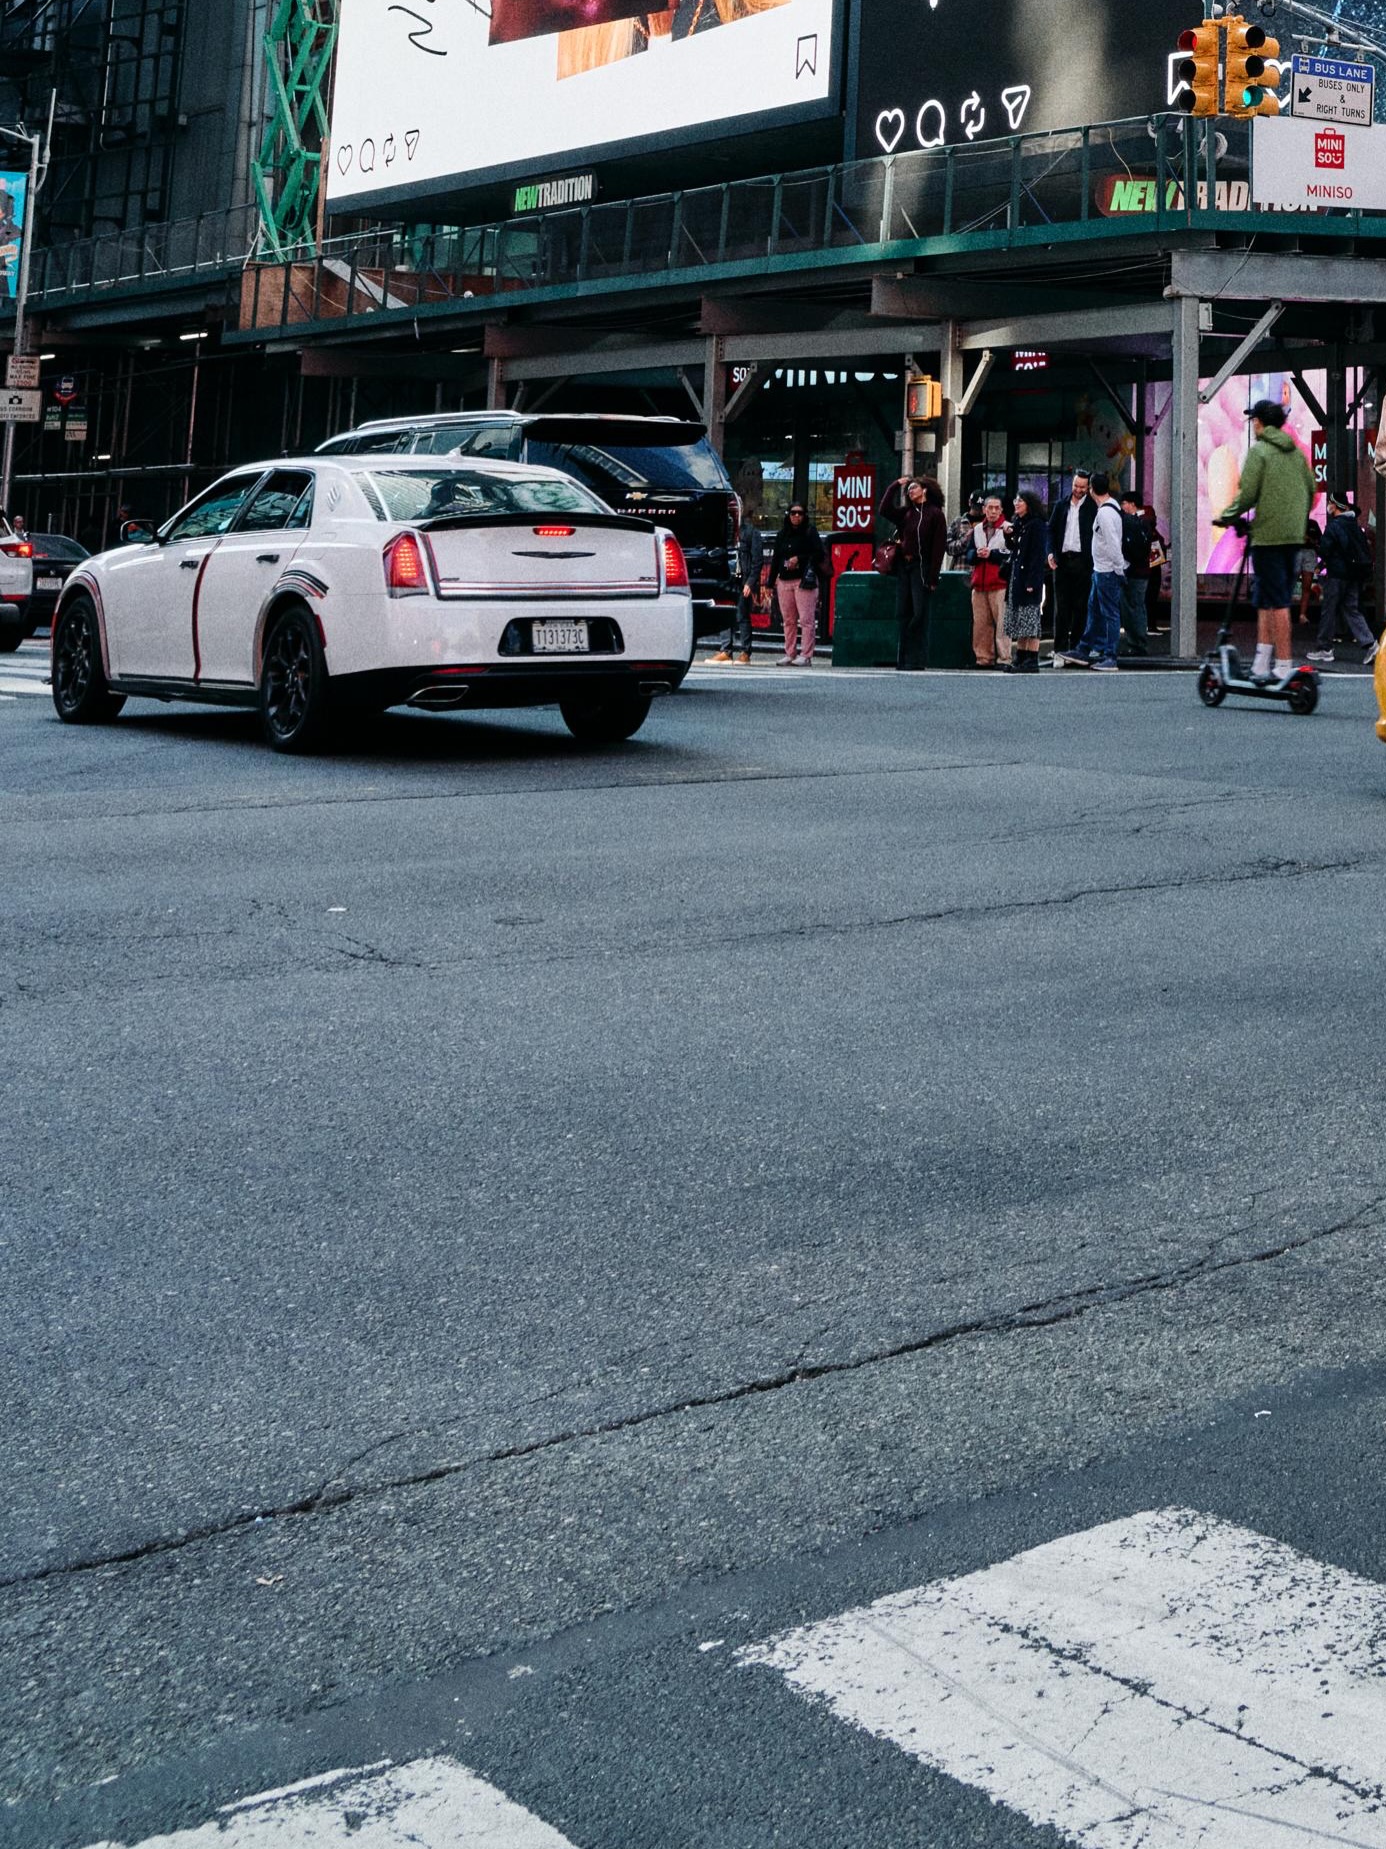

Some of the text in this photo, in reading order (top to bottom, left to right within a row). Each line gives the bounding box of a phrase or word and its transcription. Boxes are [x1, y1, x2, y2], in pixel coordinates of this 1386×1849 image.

[1314, 63, 1368, 79] BUS LANE
[1318, 78, 1365, 93] BUSES ONLY
[1339, 94, 1345, 103] &
[1316, 103, 1366, 119] RIGHT TURNS
[1317, 134, 1342, 151] MINI
[1306, 184, 1353, 200] MINISO
[837, 476, 871, 499] MINI
[535, 628, 584, 645] T131373C
